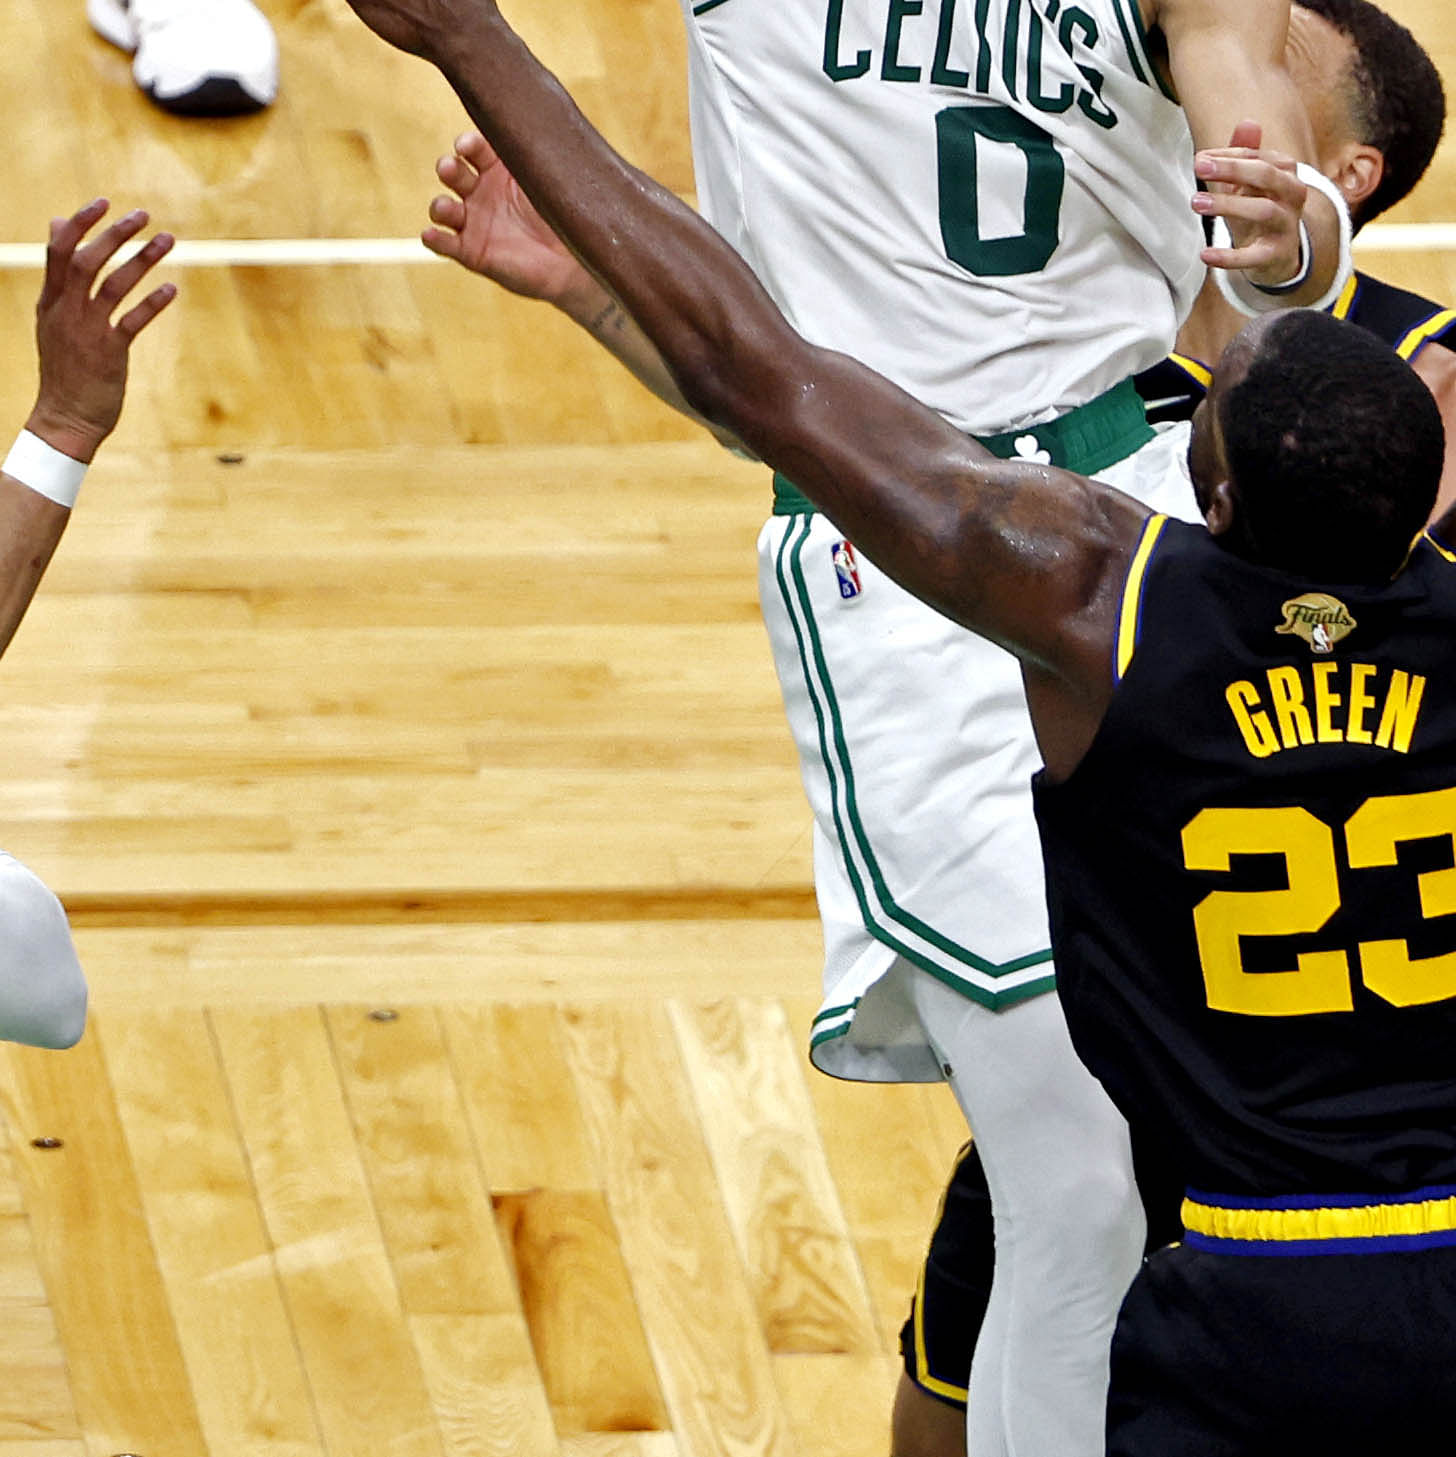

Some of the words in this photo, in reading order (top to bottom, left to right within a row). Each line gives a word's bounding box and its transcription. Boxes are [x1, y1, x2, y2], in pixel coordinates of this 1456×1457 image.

[935, 105, 1065, 277] 0
[1276, 603, 1353, 632] Finals
[1225, 661, 1426, 758] GREEN
